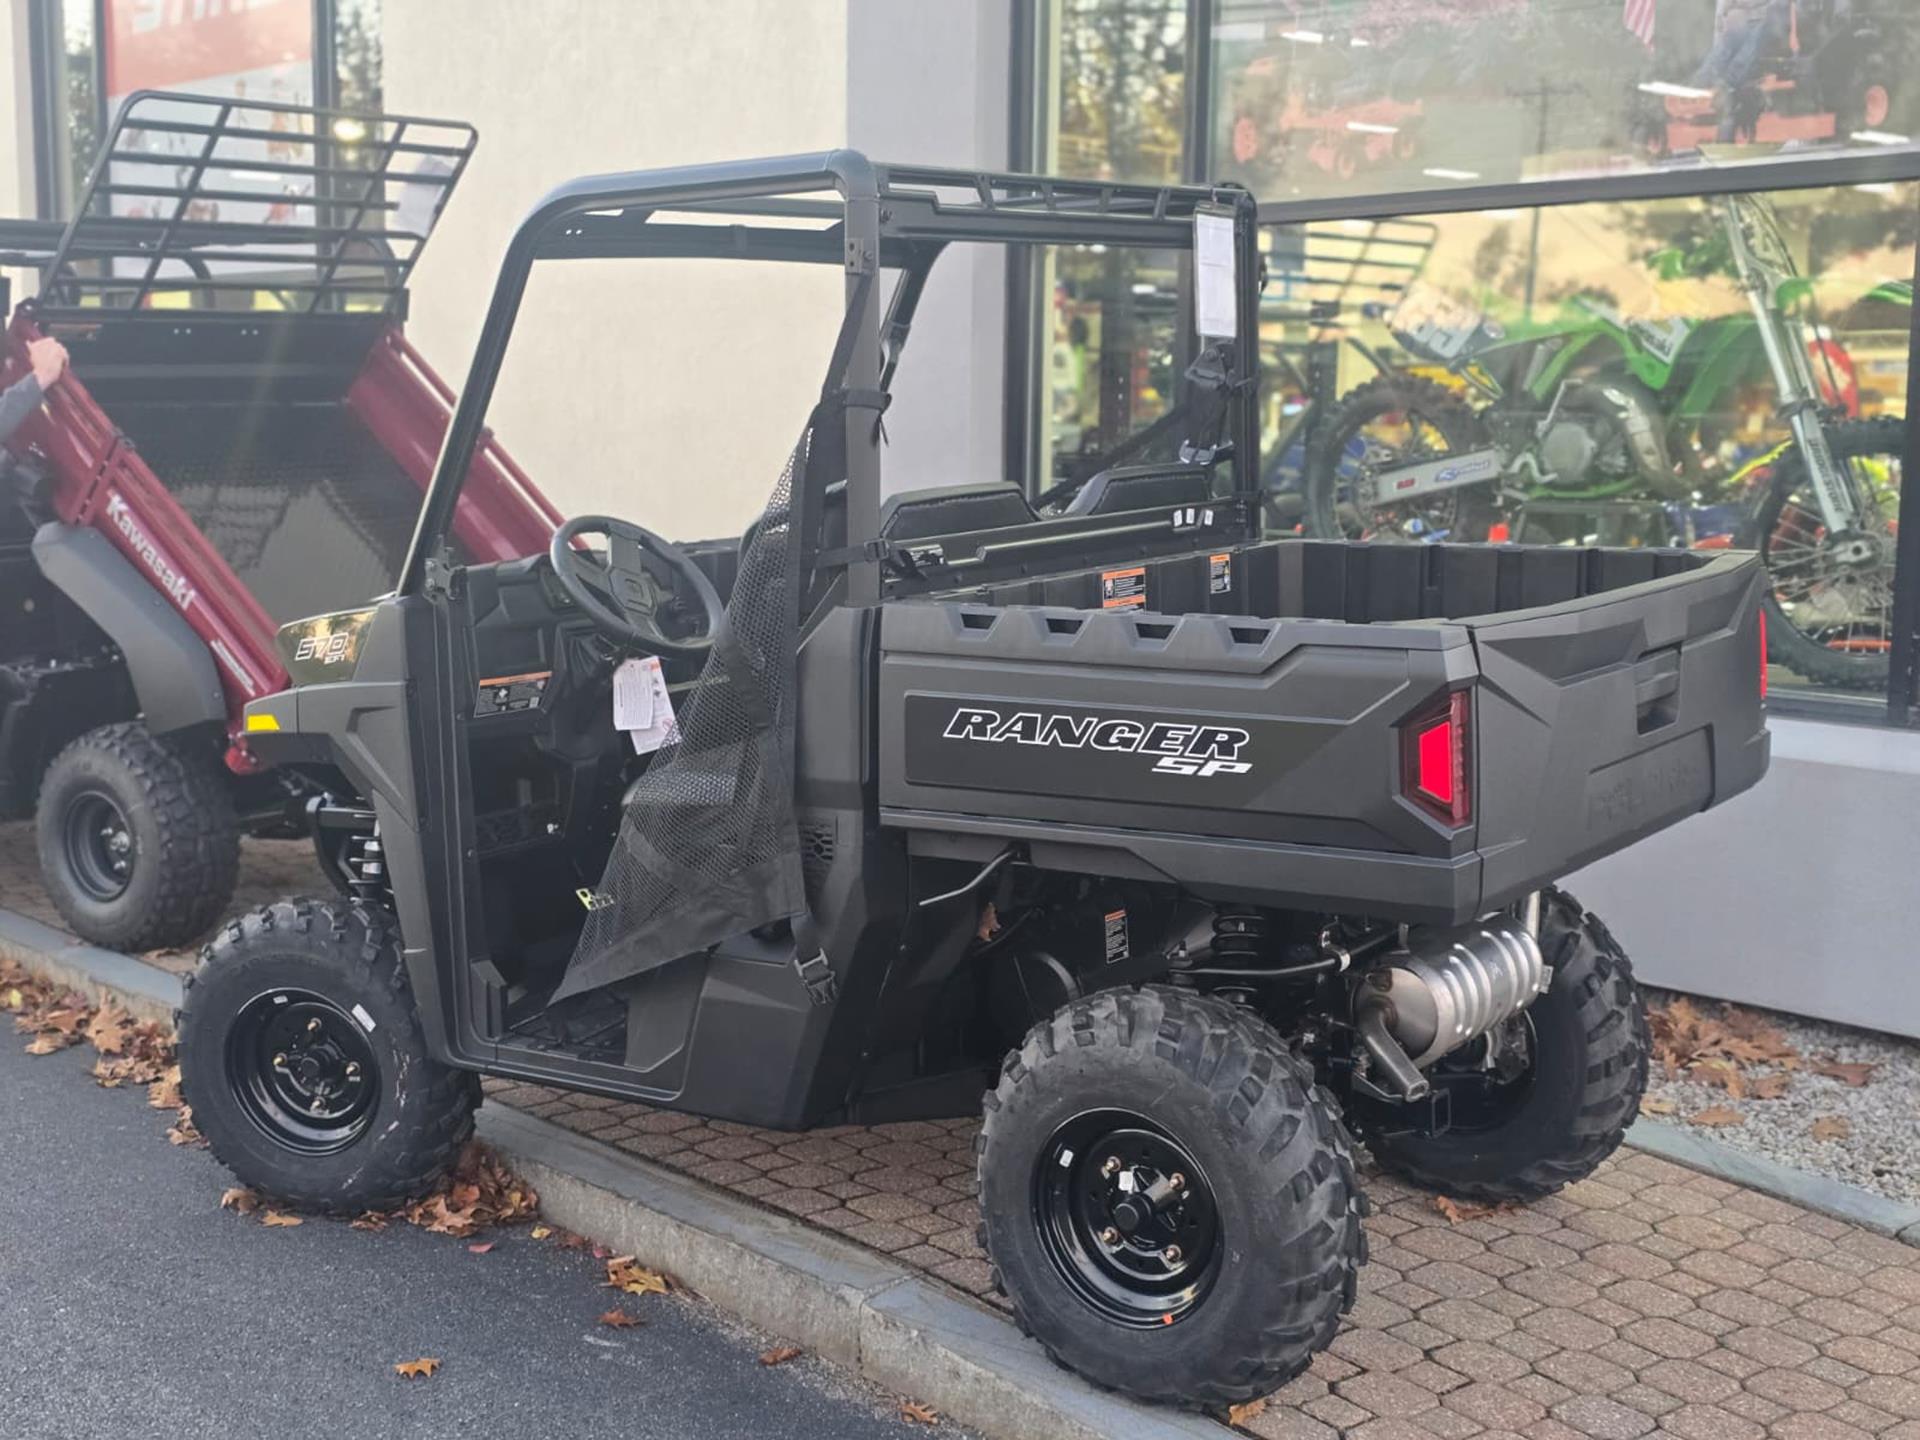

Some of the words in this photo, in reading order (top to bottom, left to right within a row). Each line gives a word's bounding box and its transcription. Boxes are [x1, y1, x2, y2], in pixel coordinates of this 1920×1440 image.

[106, 494, 197, 611] Kawasaki
[295, 632, 349, 661] 570
[943, 708, 1250, 760] RANGER
[1151, 756, 1254, 777] SP
